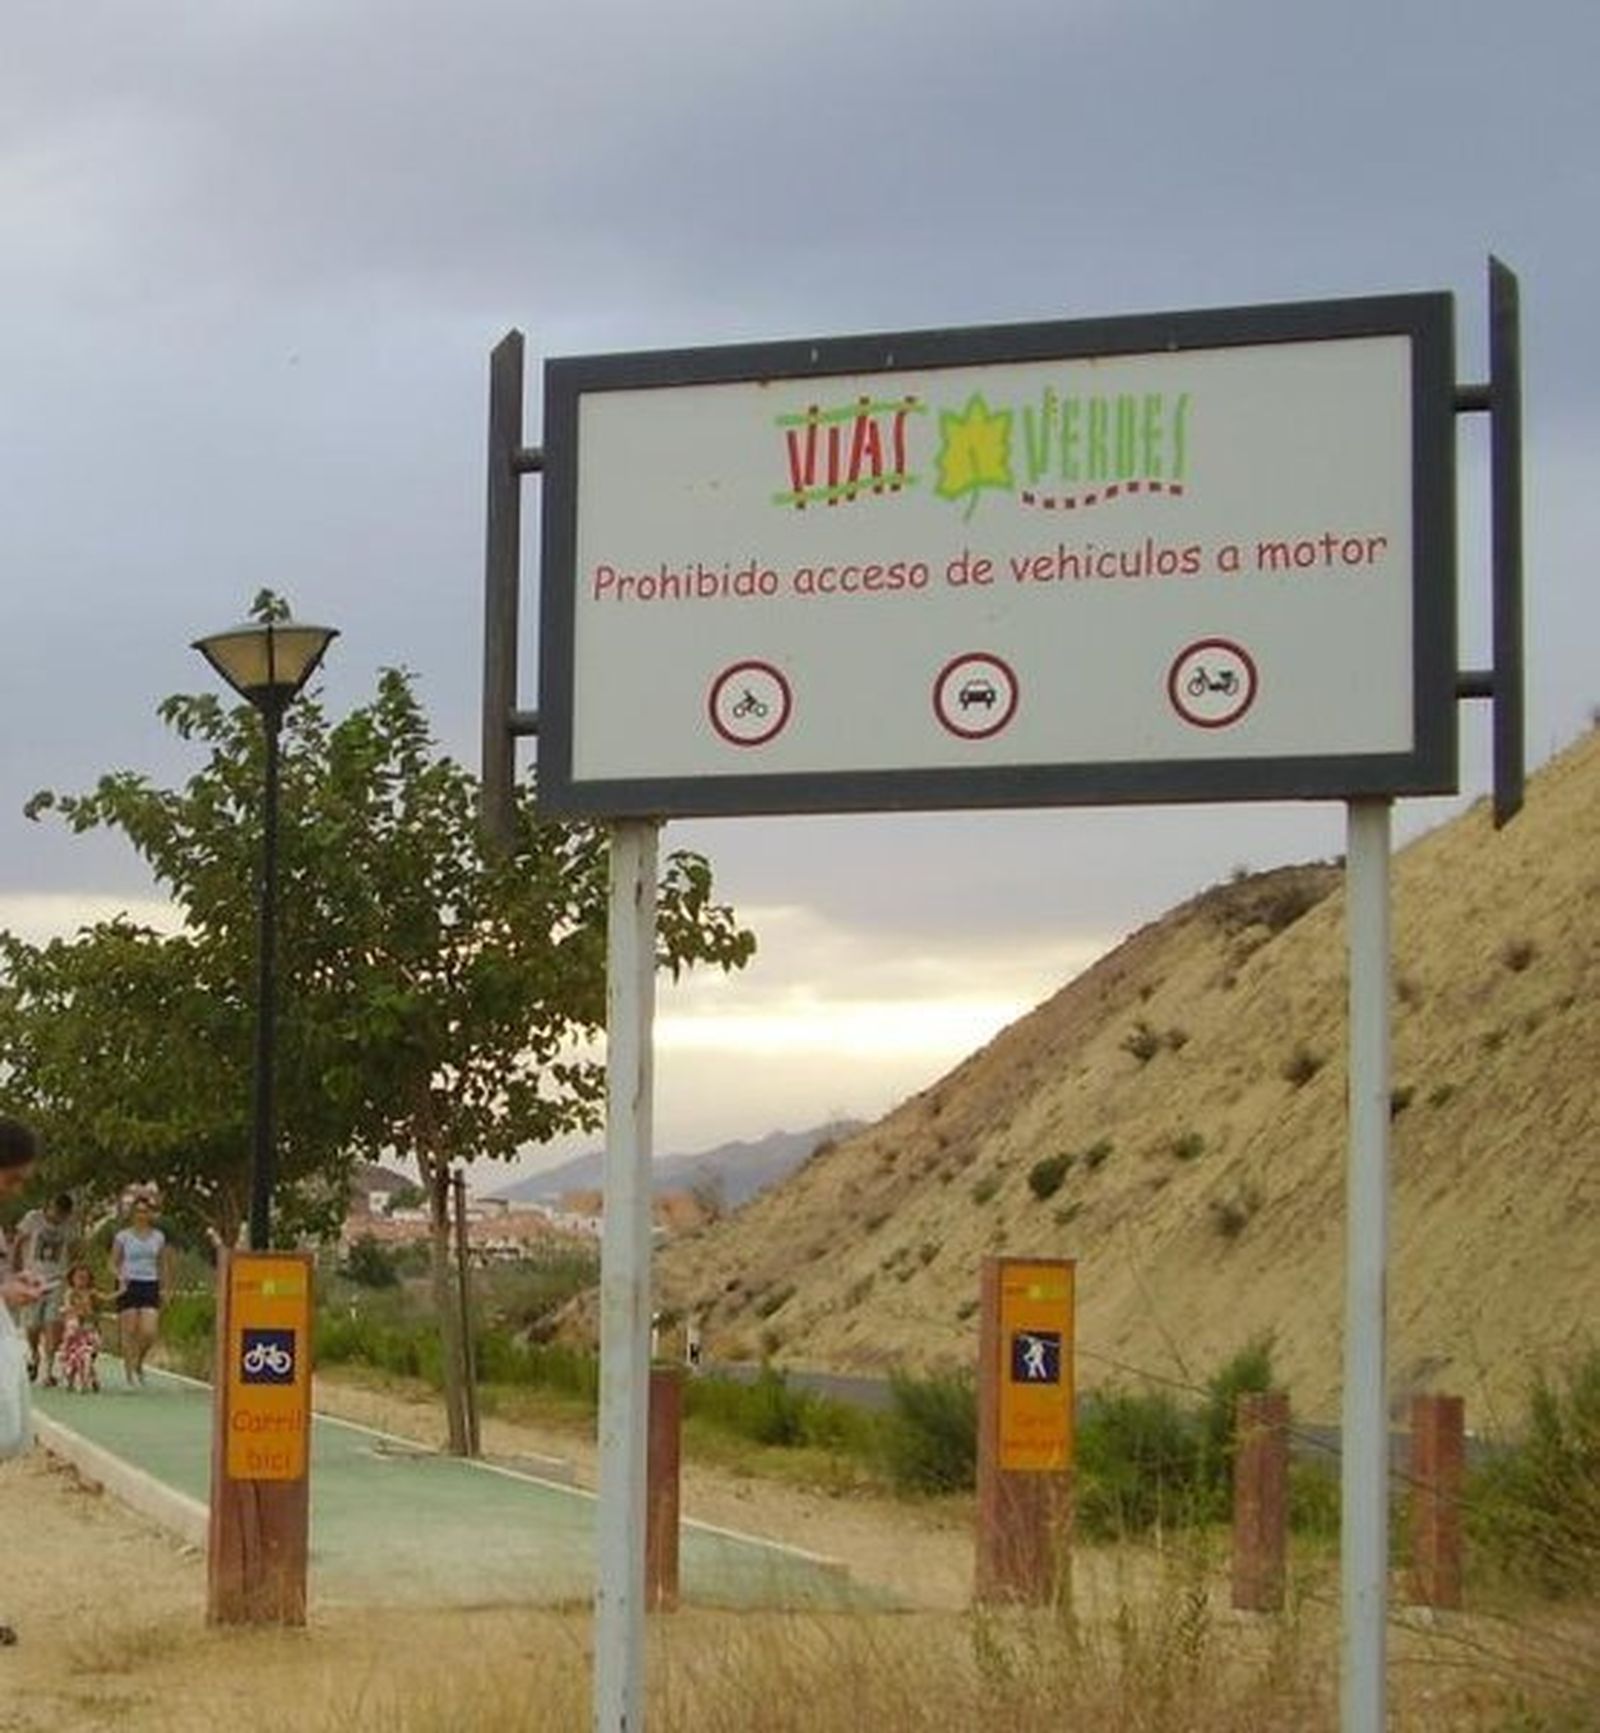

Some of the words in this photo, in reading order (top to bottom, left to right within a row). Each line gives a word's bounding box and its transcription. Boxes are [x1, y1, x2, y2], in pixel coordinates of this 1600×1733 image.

[786, 396, 917, 510] VIAS
[1023, 388, 1191, 484] VERDES
[593, 564, 778, 602] Prohibido
[793, 559, 930, 596] acceso
[946, 548, 995, 586] de
[1217, 544, 1240, 572] a
[1257, 532, 1388, 571] motor
